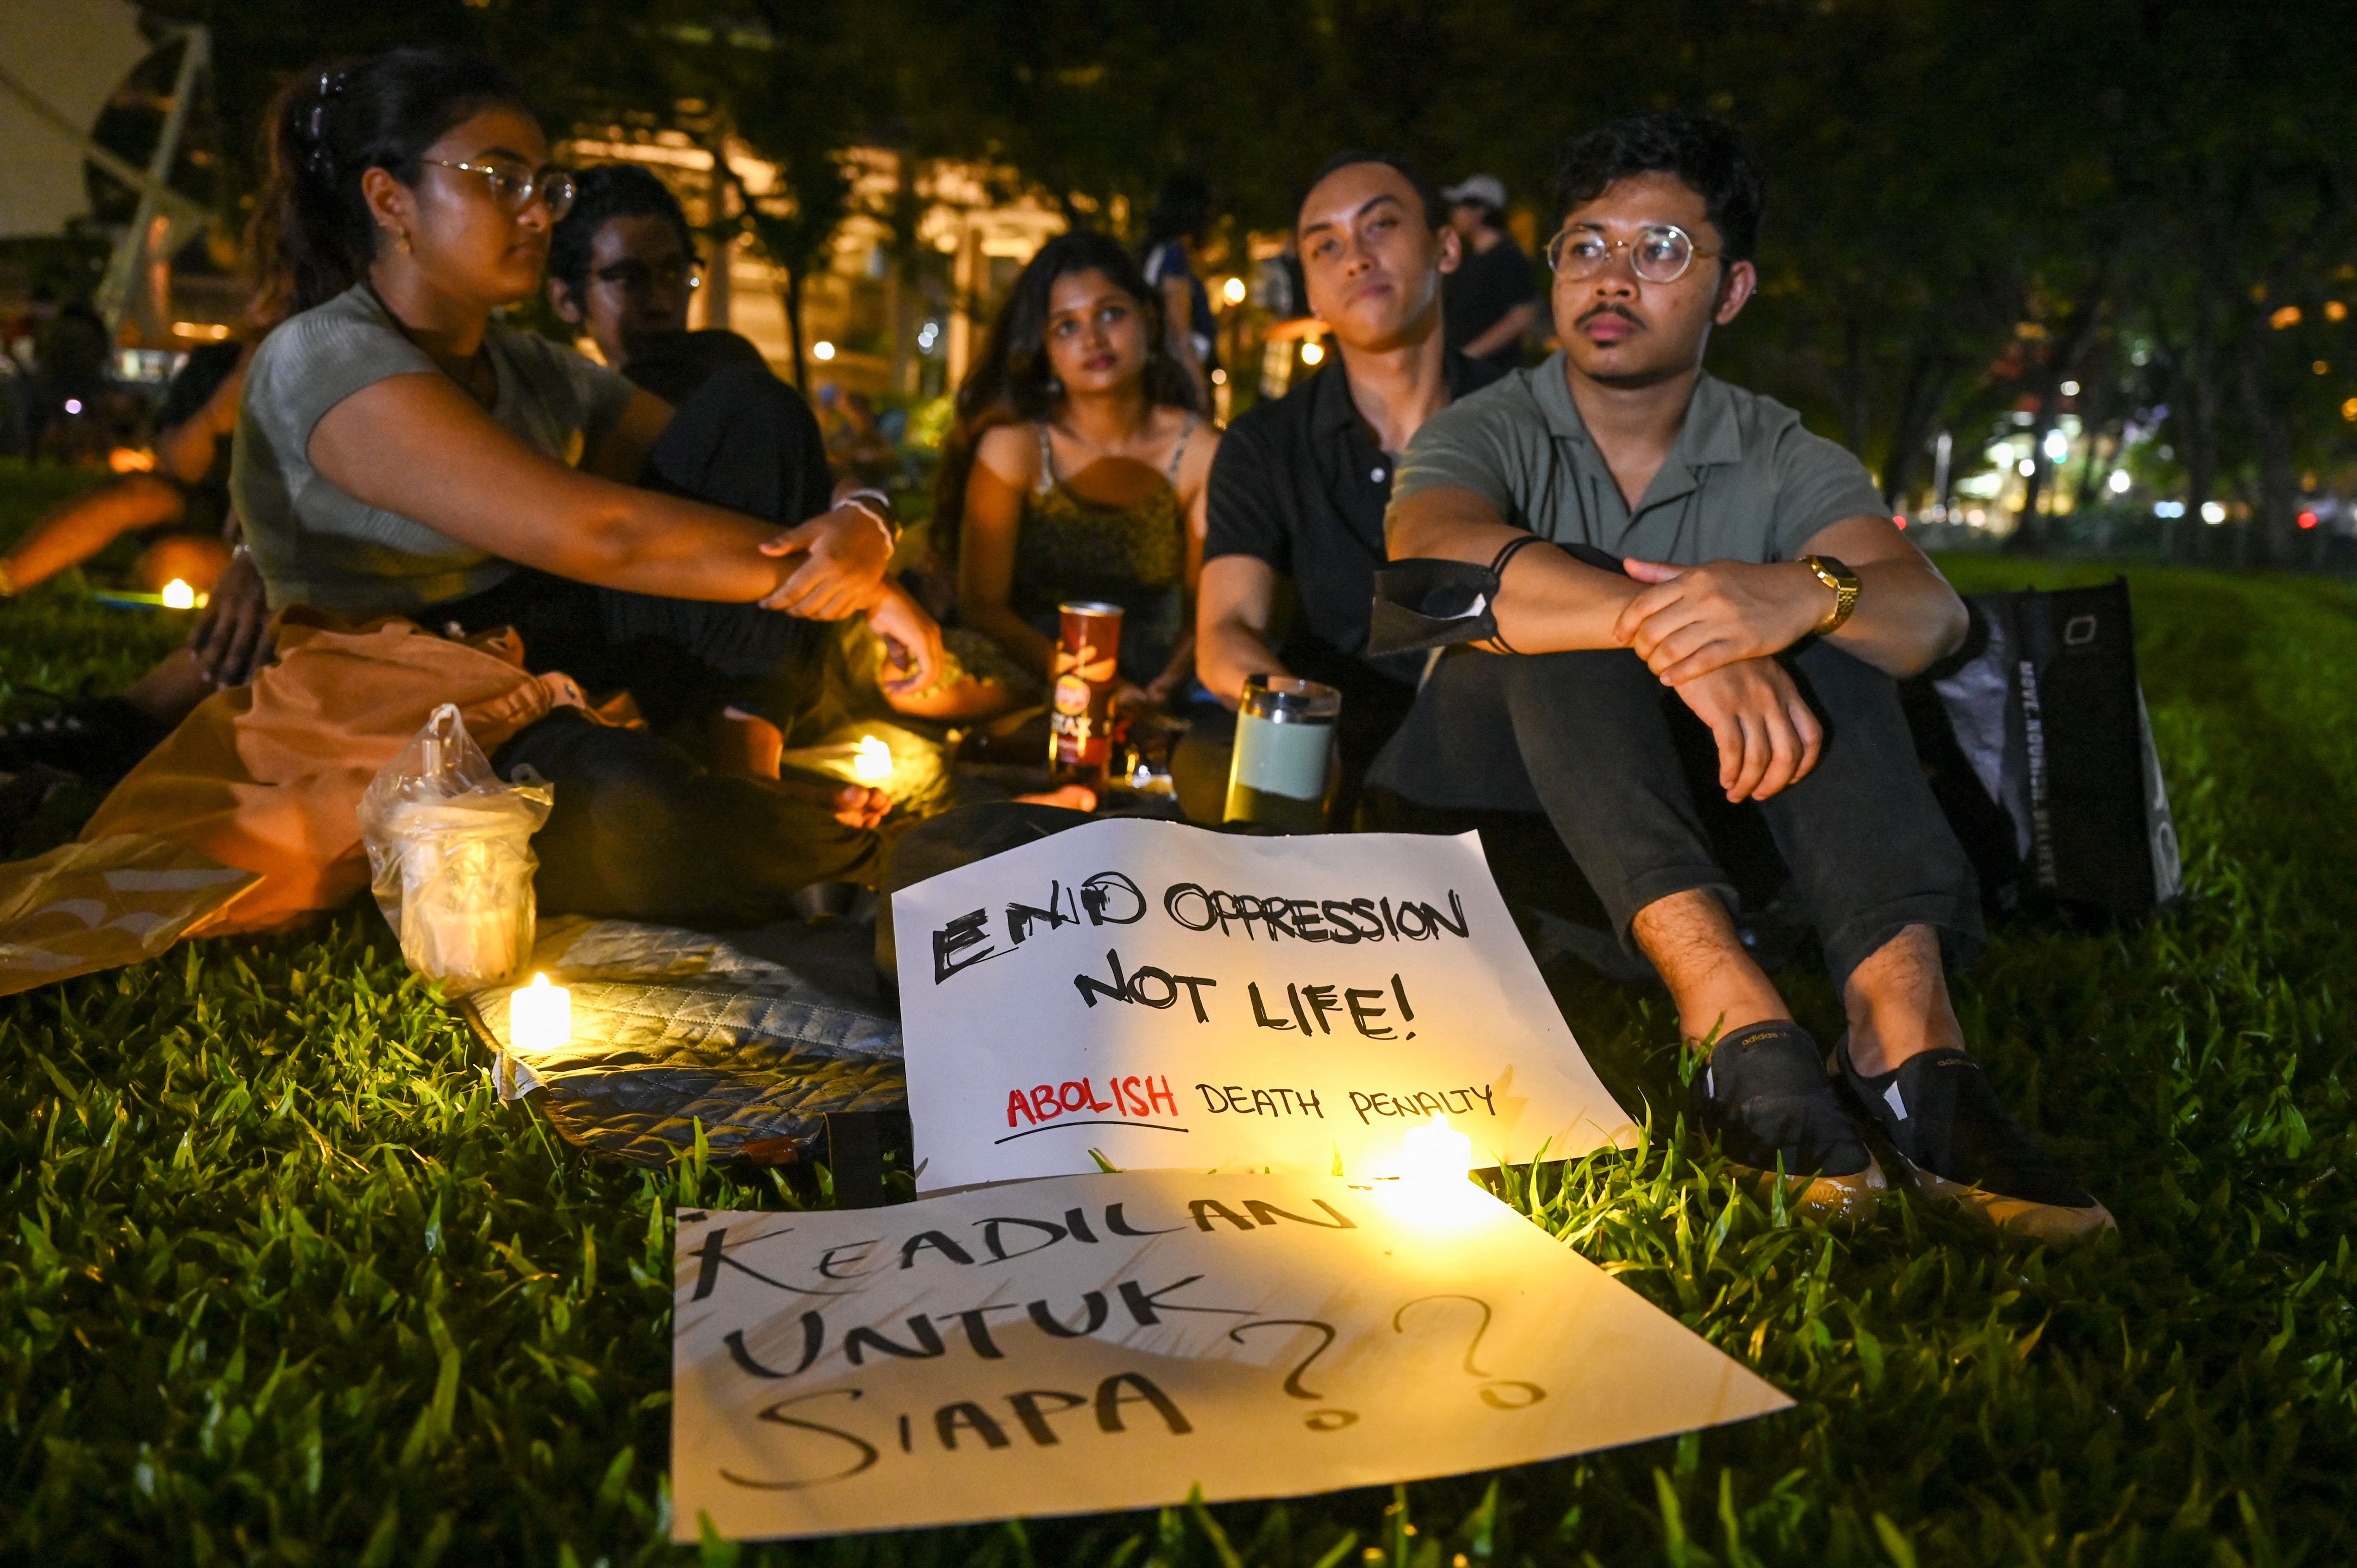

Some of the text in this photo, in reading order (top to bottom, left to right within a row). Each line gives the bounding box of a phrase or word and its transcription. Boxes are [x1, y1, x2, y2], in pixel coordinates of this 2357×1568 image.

[933, 871, 1471, 985] END OPPRESSION
[1074, 948, 1416, 1041] NOT LIFE!
[1006, 1074, 1497, 1127] ABOLISH DEATH PENALTY
[677, 1198, 1359, 1303] KEADILAN
[721, 1274, 1259, 1381] UNTUK
[719, 1368, 1194, 1492] SIAPA
